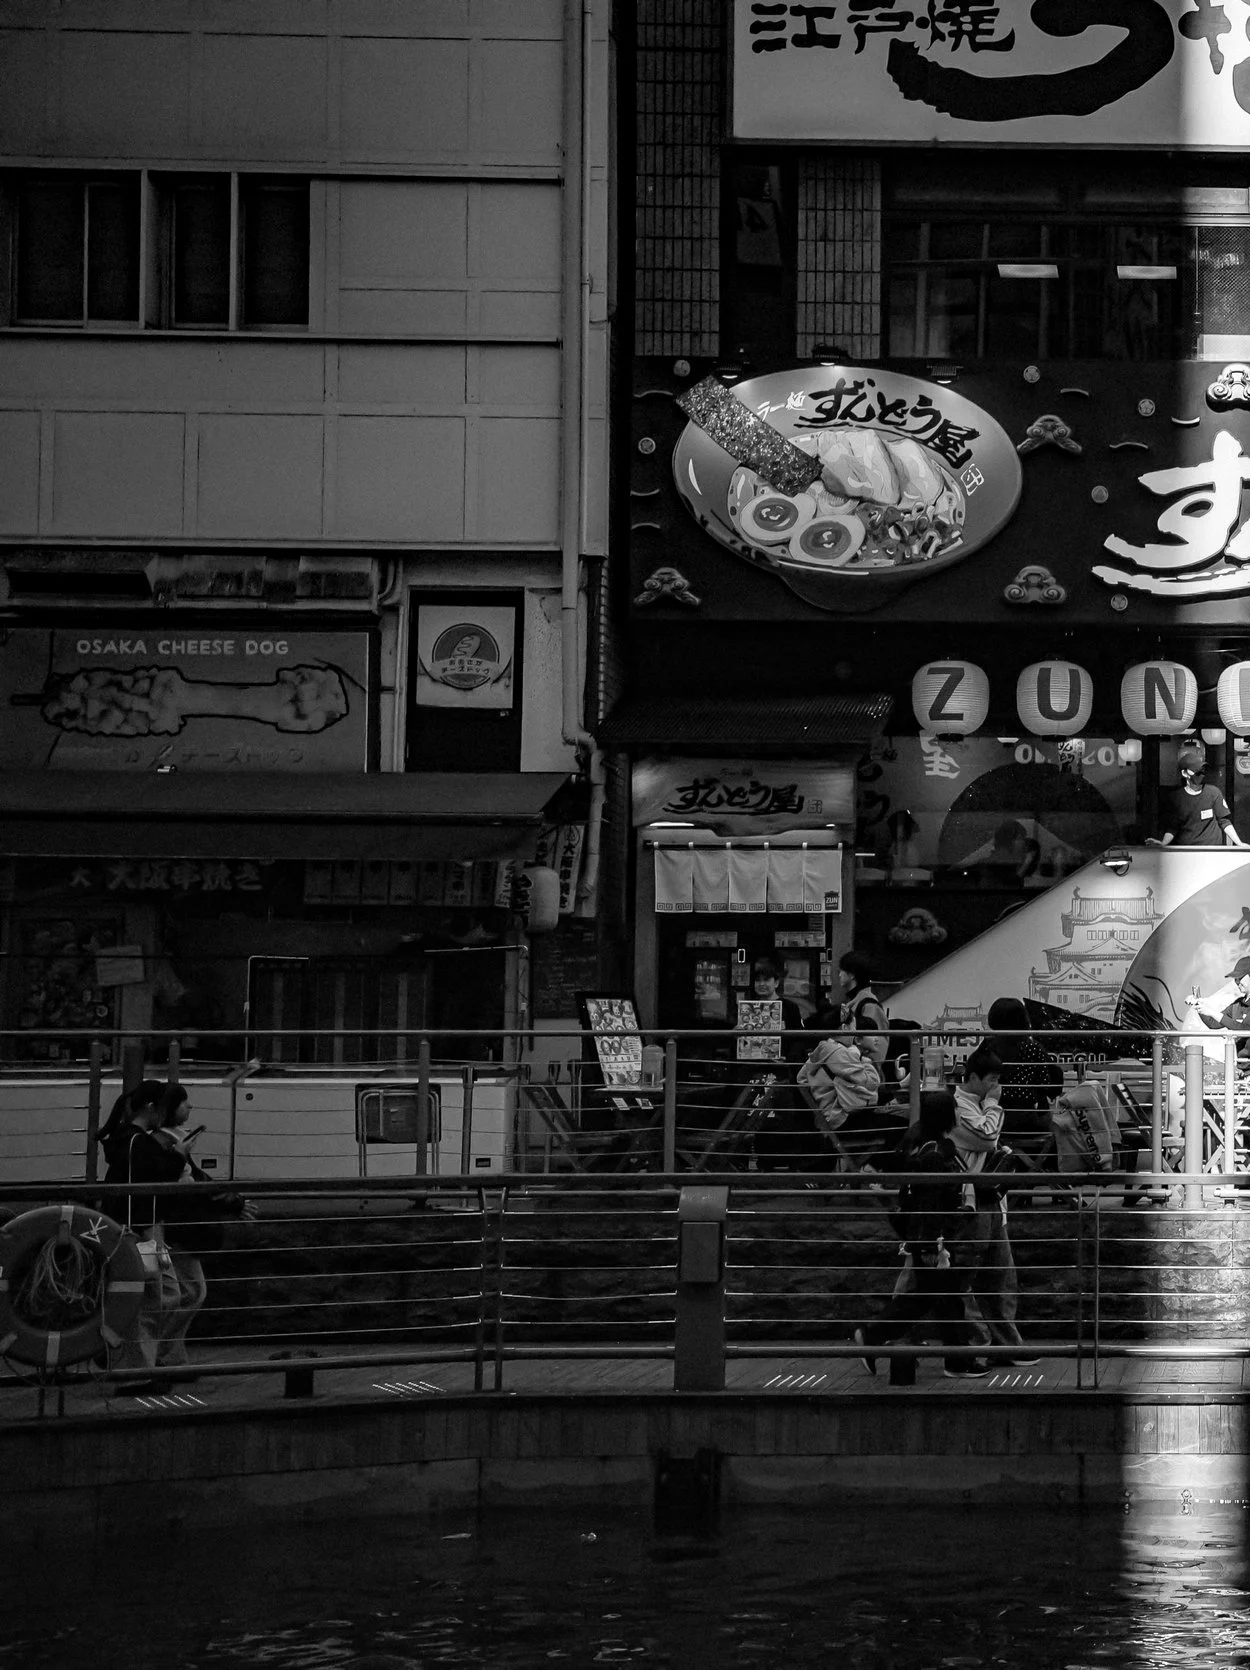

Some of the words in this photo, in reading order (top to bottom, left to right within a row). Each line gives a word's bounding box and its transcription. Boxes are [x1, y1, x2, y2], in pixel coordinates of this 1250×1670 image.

[793, 378, 982, 470] ずんどう屋
[76, 639, 148, 656] OSAKA
[157, 639, 235, 656] CHEESE
[245, 639, 289, 656] DOG
